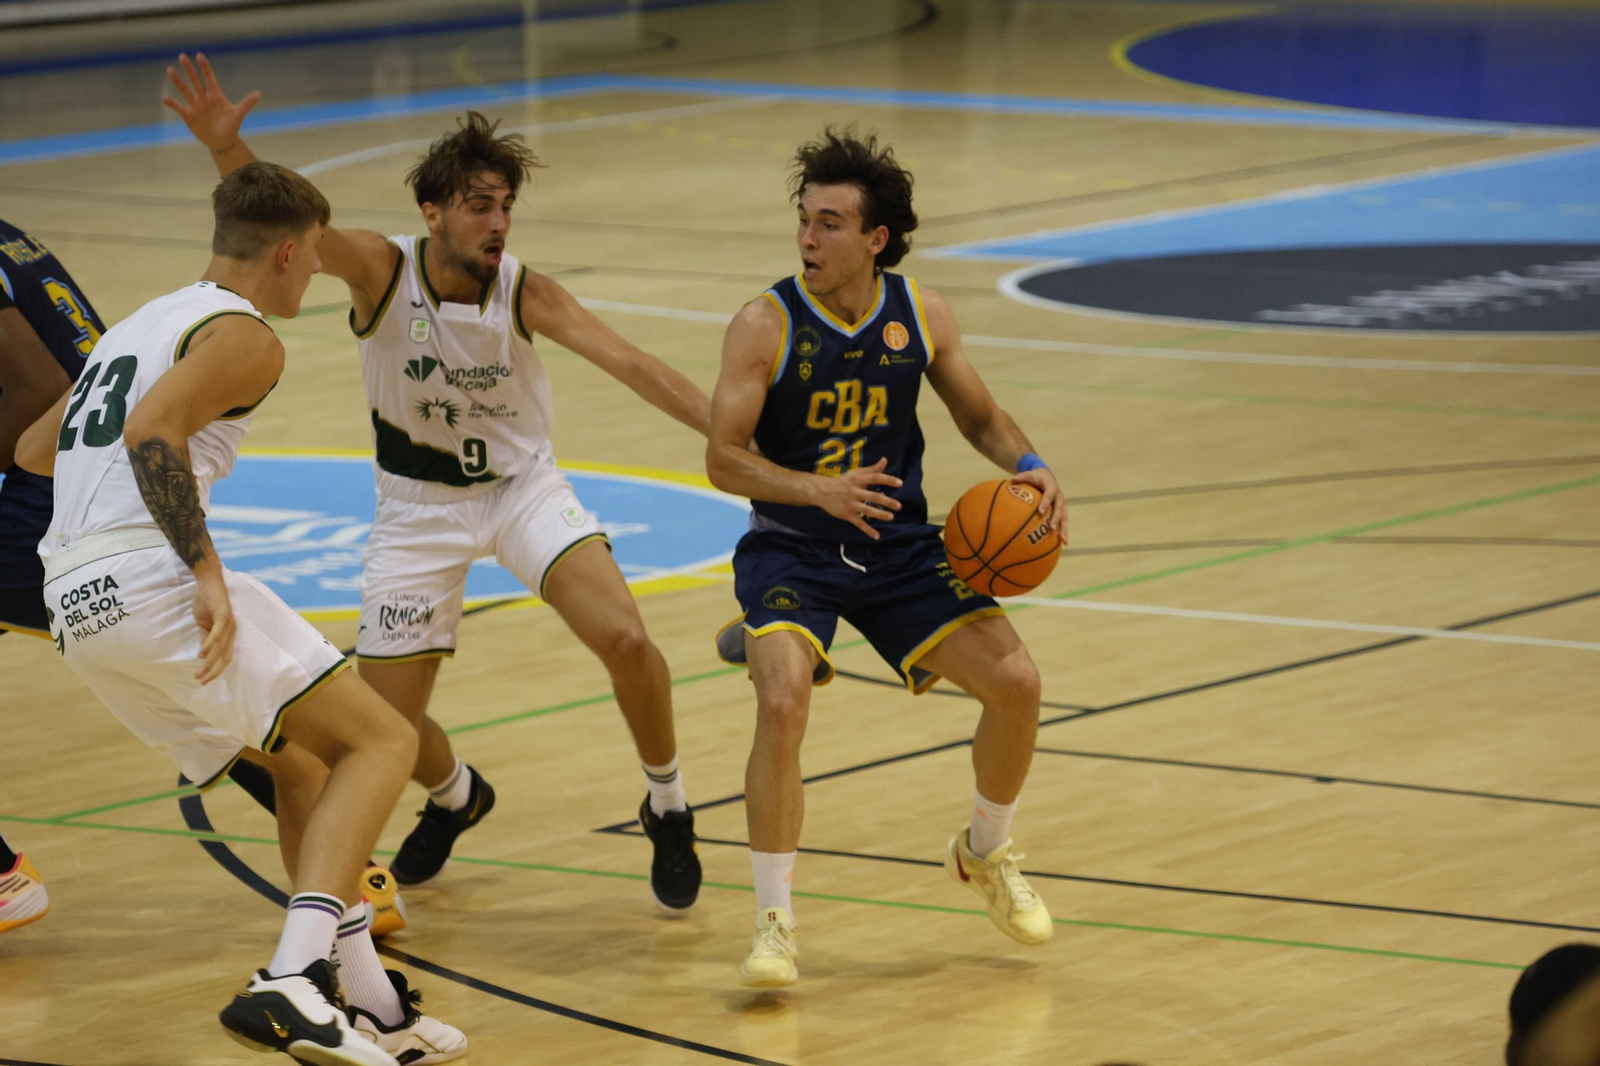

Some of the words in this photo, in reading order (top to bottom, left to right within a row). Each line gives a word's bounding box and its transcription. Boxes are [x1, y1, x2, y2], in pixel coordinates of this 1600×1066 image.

[42, 277, 102, 358] 3
[56, 355, 138, 453] 23
[806, 378, 889, 434] CBA
[463, 438, 487, 474] 9
[813, 436, 868, 478] 21
[60, 574, 120, 610] COSTA
[65, 608, 89, 628] DEL
[89, 595, 124, 616] SOL
[72, 608, 130, 642] MÁLAGA
